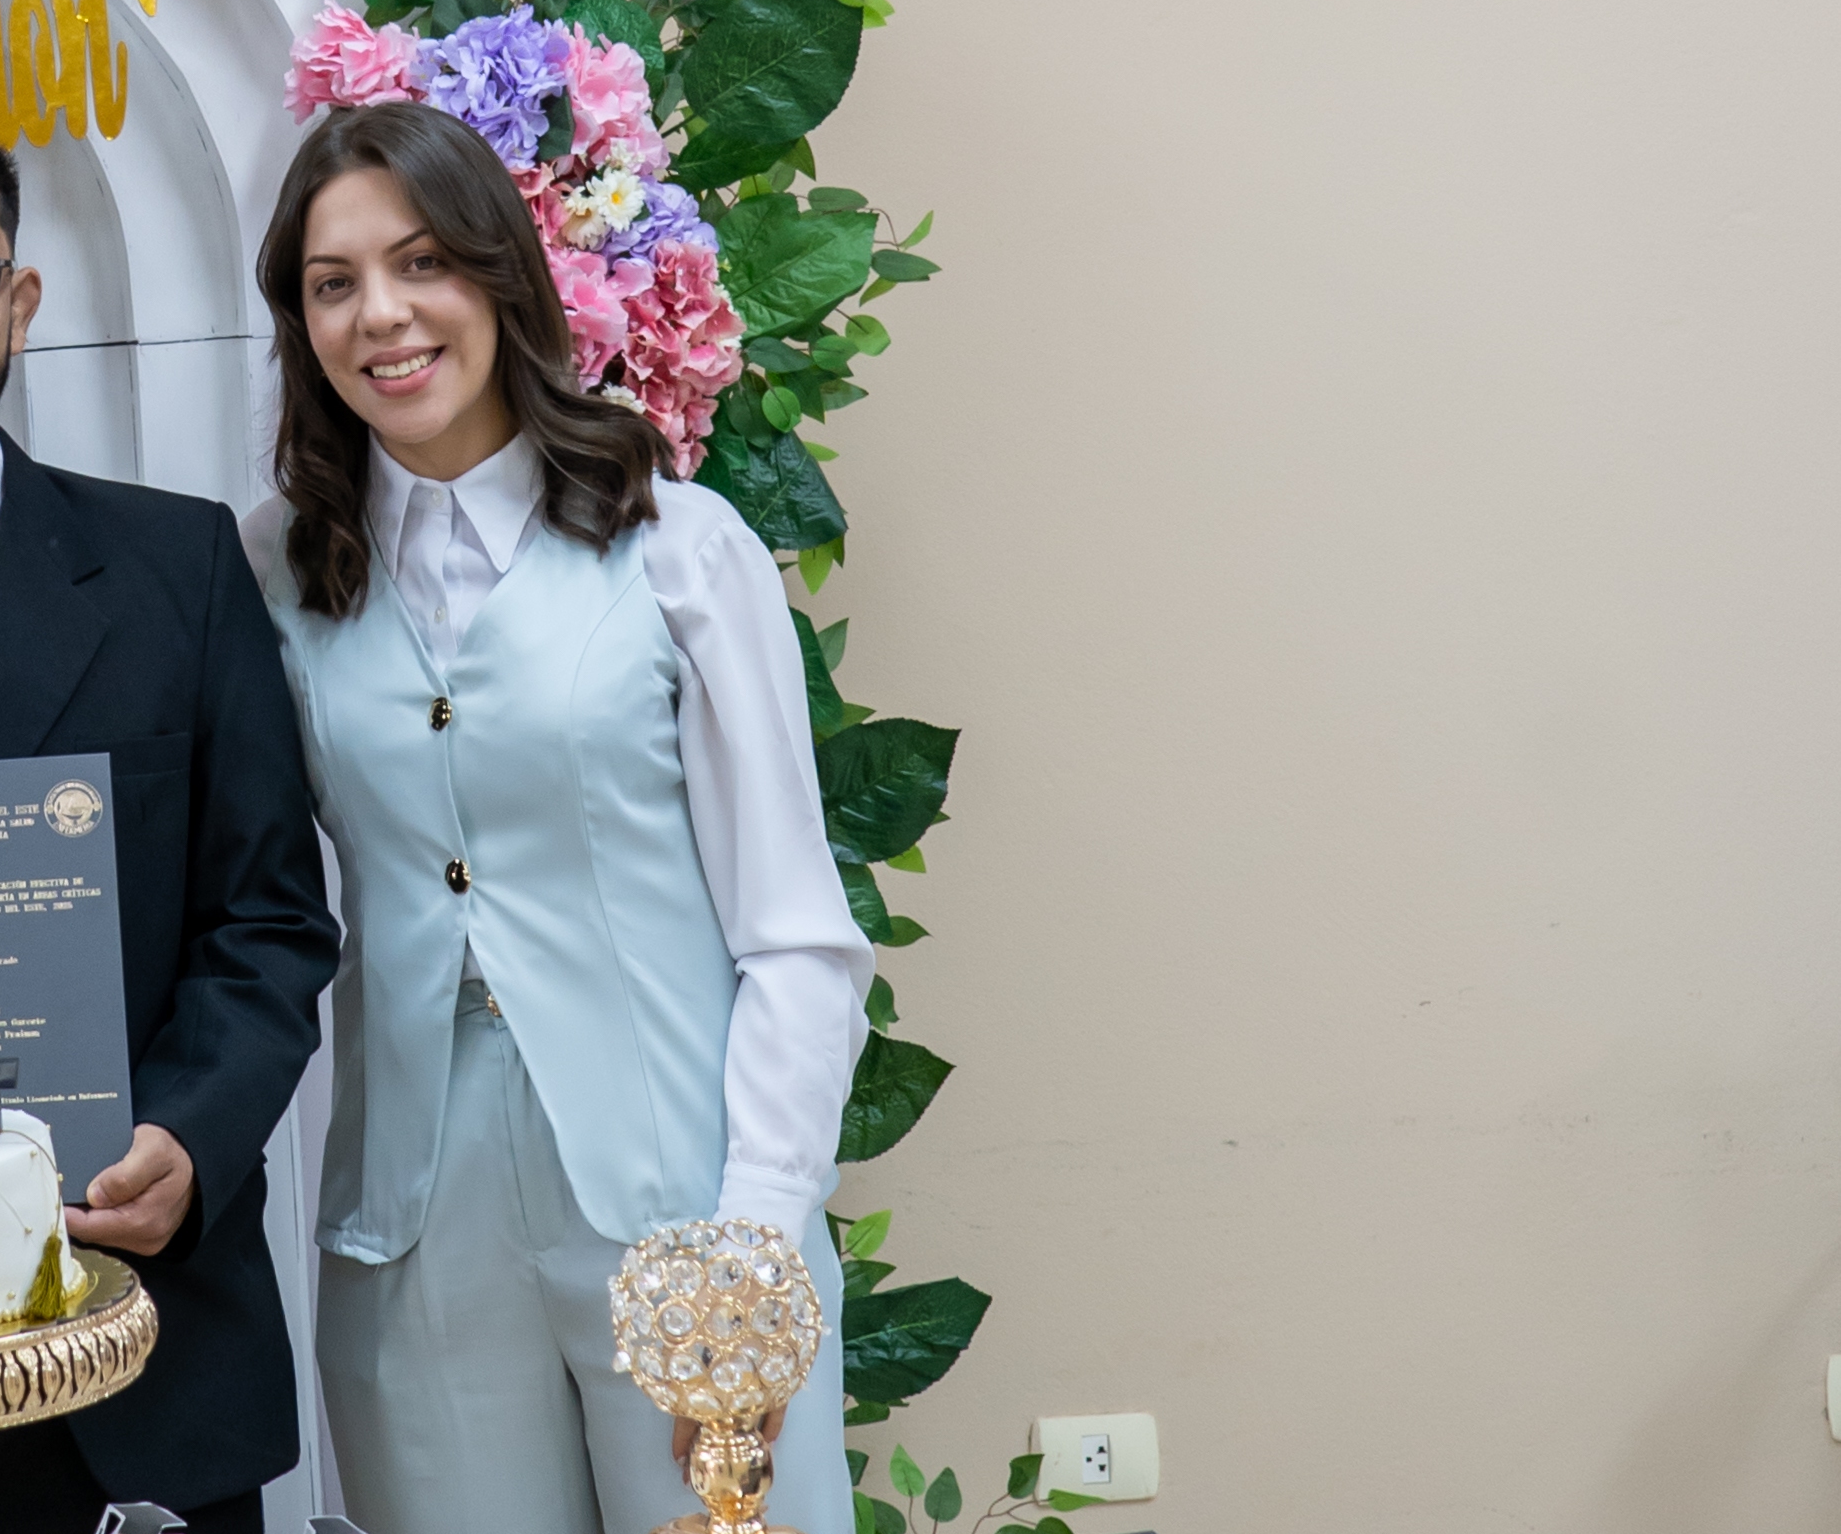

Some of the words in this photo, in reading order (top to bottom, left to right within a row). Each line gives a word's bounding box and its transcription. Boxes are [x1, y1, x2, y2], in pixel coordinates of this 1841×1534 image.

[14, 804, 40, 817] ESTE
[9, 817, 35, 828] SALUD
[61, 886, 102, 899] CRÍTICAS
